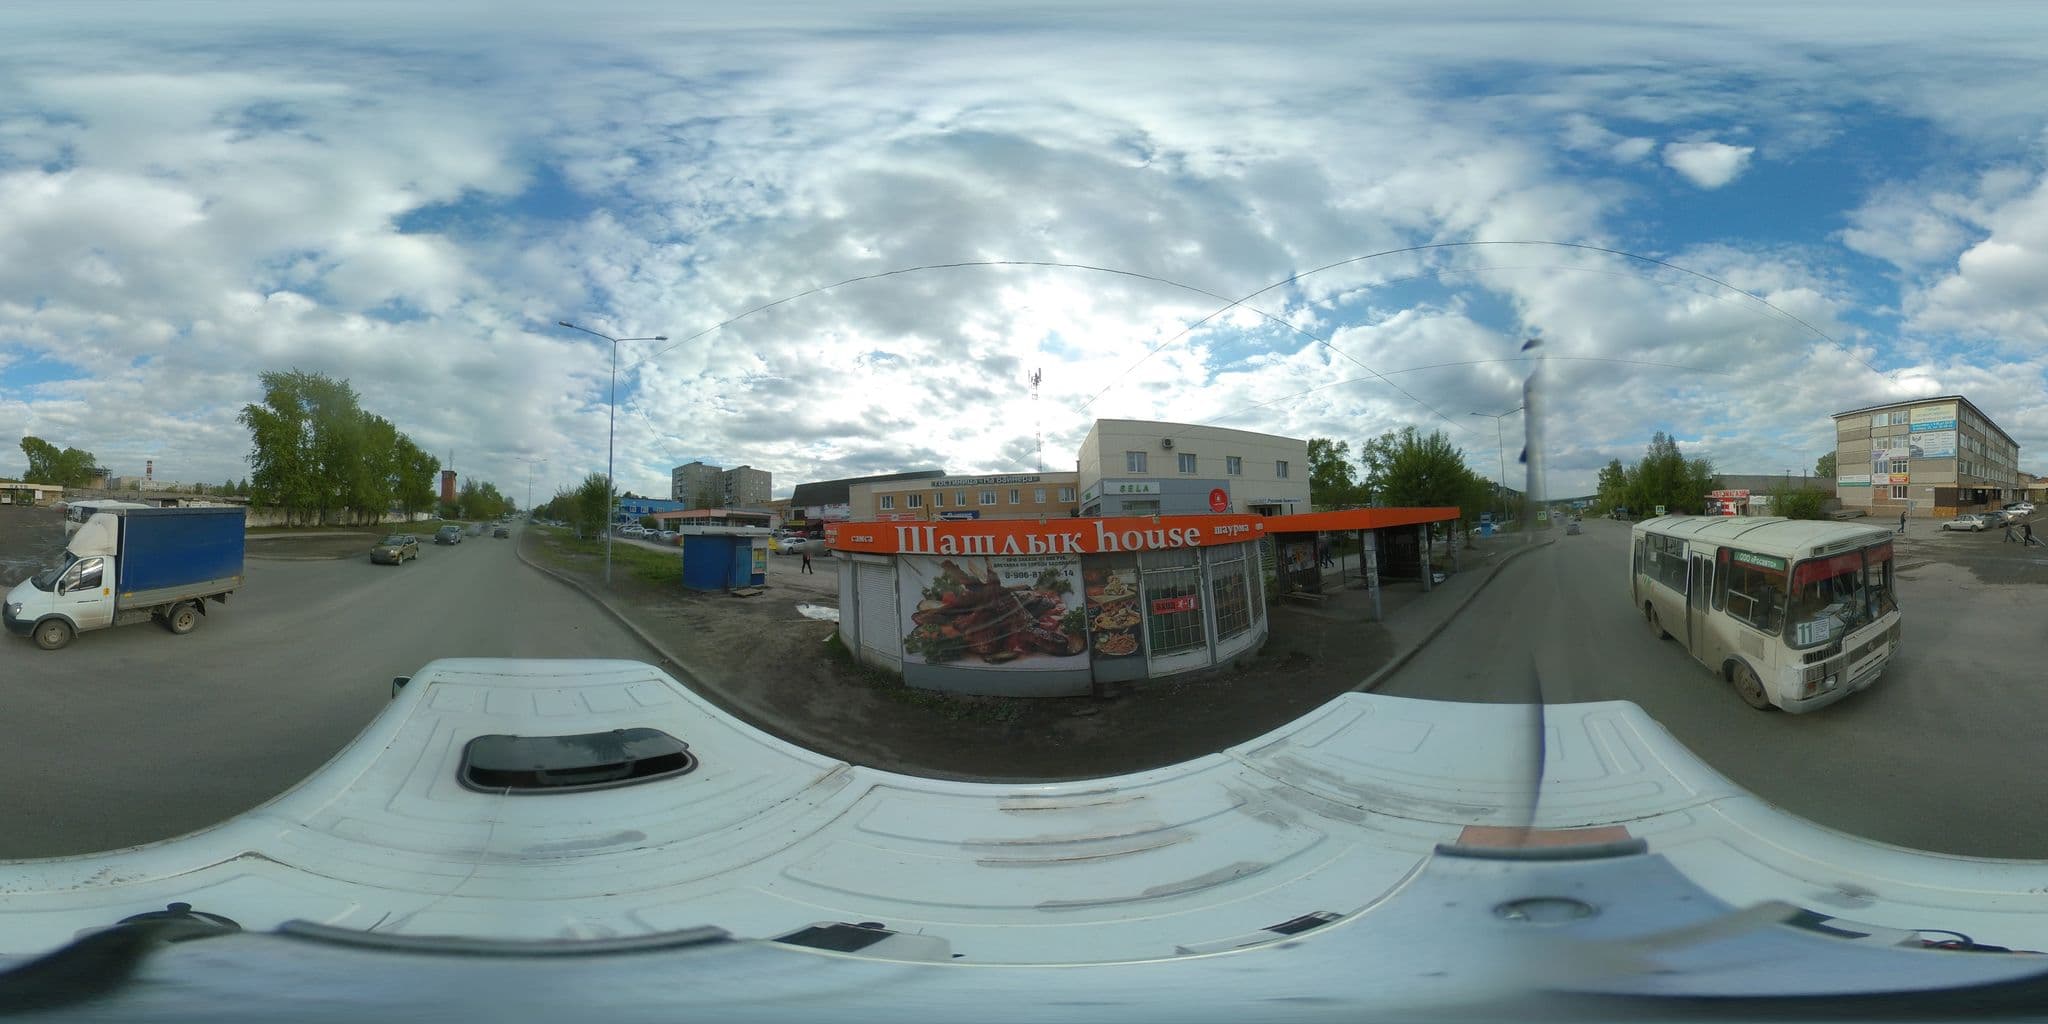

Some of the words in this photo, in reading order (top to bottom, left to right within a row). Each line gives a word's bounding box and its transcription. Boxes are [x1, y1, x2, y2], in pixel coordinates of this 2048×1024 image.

[1120, 485, 1149, 493] SELA
[1214, 523, 1249, 537] шаурма
[851, 535, 873, 543] самса
[895, 526, 1086, 555] Шашлык
[1094, 521, 1201, 552] house
[1799, 623, 1813, 644] 11
